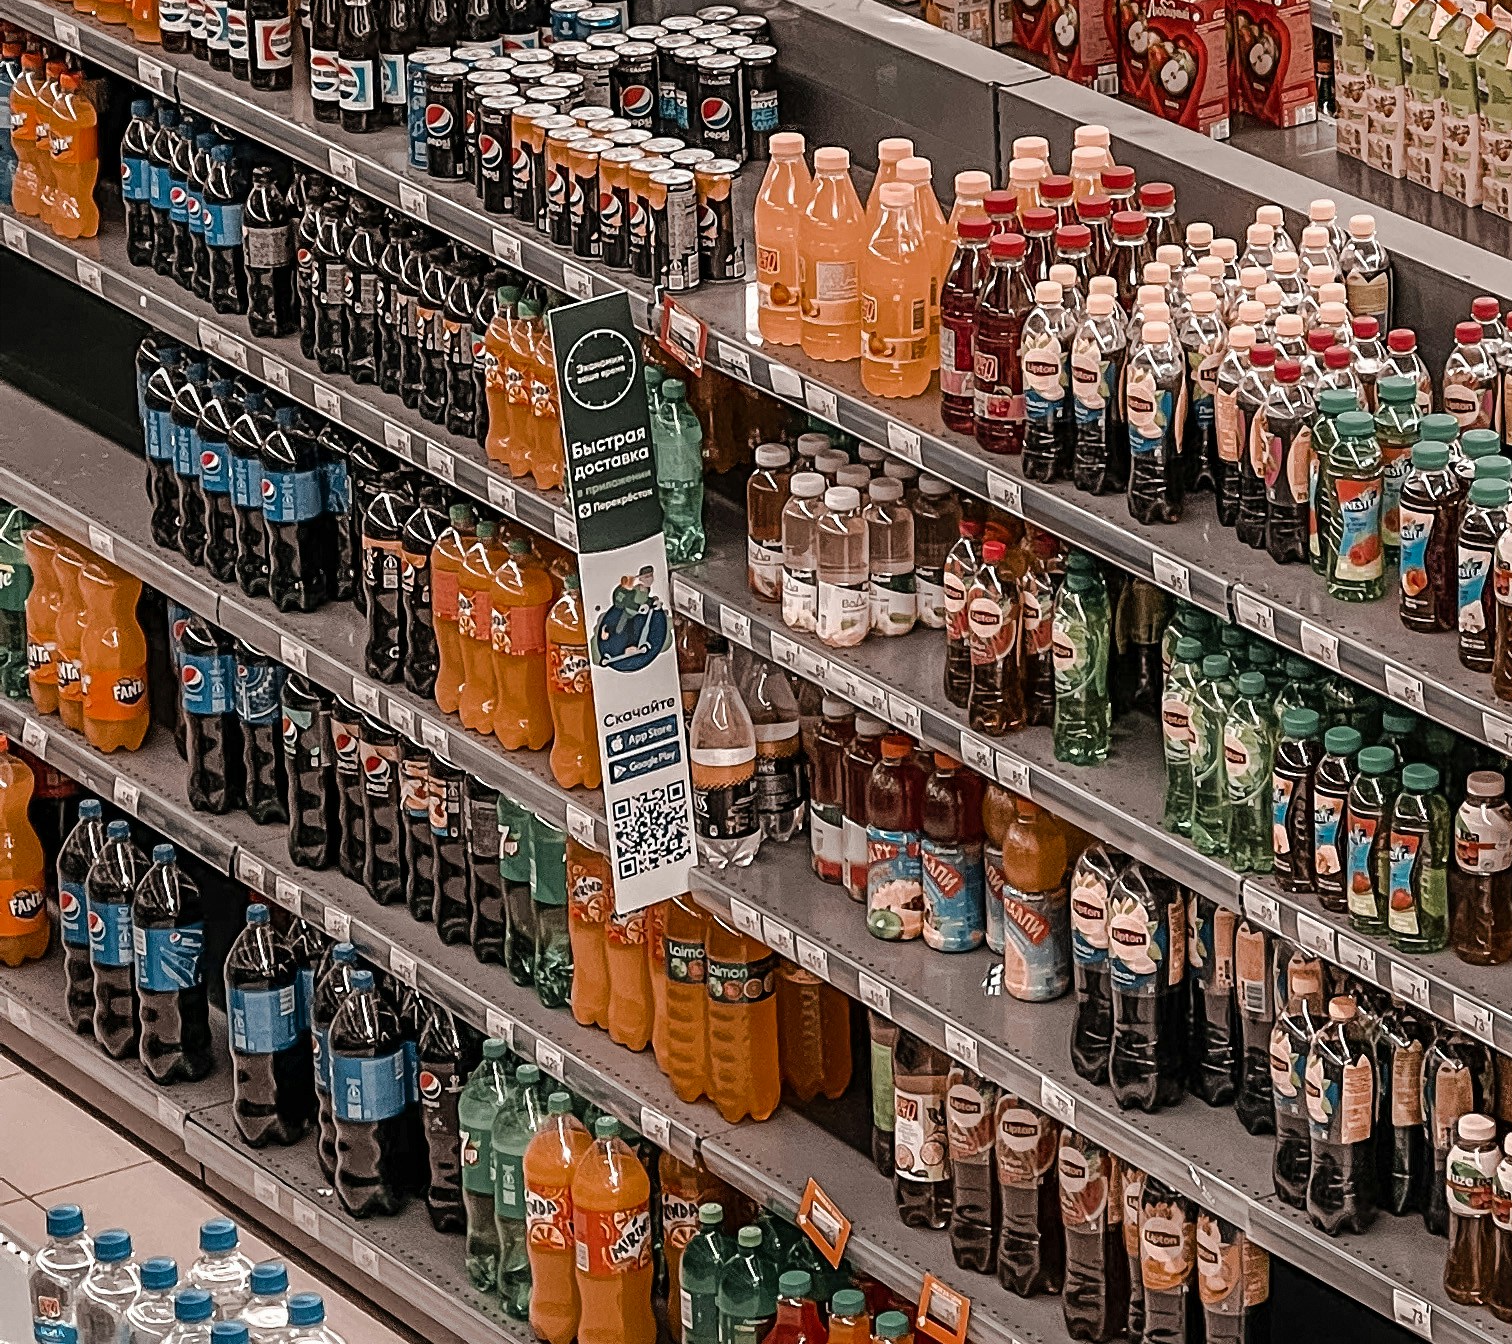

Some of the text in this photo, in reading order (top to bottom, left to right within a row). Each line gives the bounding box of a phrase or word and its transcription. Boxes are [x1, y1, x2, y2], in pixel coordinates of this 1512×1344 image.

[572, 427, 646, 459] Быстрая
[574, 446, 649, 481] доставка
[114, 680, 146, 703] FANT
[603, 696, 675, 728] Скачайте
[9, 892, 43, 918] FANT
